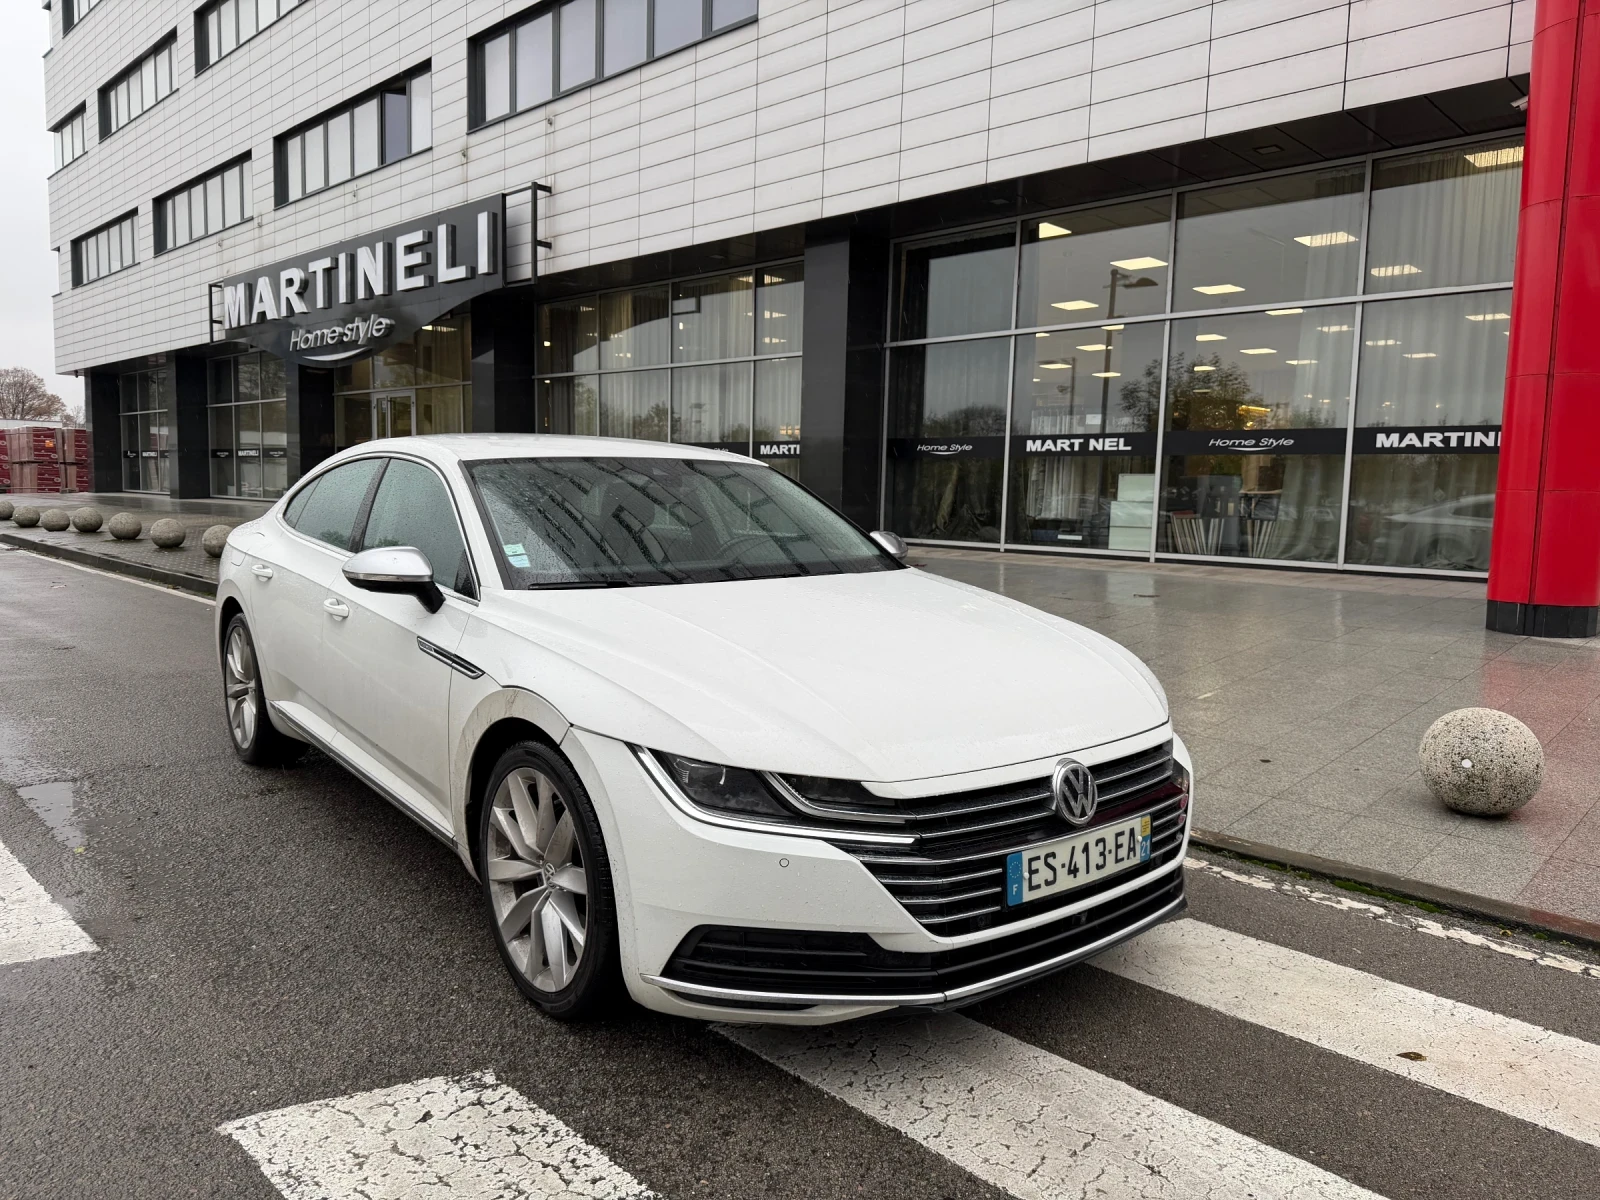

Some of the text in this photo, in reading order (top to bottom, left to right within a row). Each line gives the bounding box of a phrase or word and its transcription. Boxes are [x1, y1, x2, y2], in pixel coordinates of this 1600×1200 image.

[224, 211, 498, 330] MARTINELI
[290, 326, 344, 352] Home
[949, 443, 973, 452] Style
[1208, 437, 1295, 448] Home Style
[1375, 431, 1502, 448] MARTIN
[1140, 839, 1151, 857] 21
[1027, 826, 1137, 892] ES-413-EA
[1012, 883, 1019, 896] F
